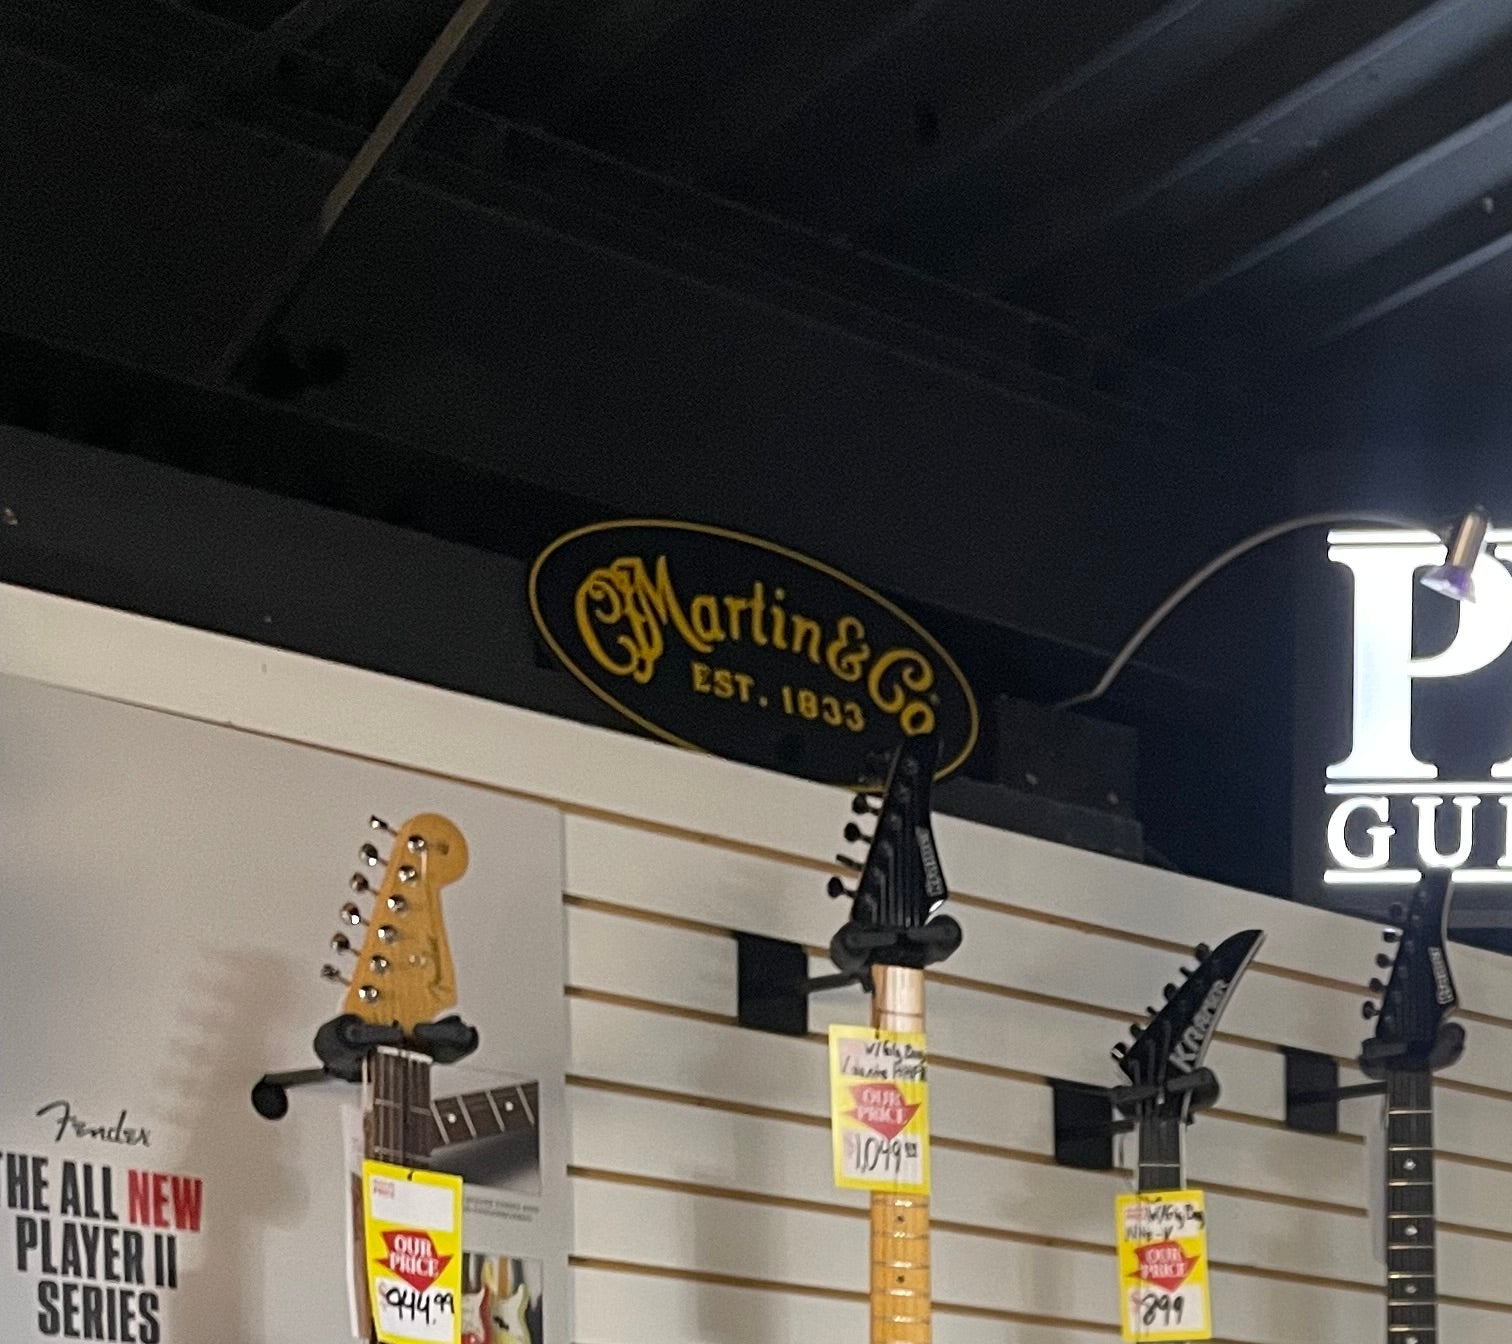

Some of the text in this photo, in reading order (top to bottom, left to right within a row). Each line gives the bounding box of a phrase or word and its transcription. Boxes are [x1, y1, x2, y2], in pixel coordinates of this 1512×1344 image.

[690, 662, 868, 733] EST. 1833
[36, 1100, 152, 1148] Fender
[0, 1150, 203, 1232] HE ALL NEW
[16, 1216, 178, 1289] PLAYER II
[393, 1233, 433, 1258] OUR
[1145, 1247, 1182, 1264] OUR
[388, 1252, 439, 1278] PRICE
[1140, 1263, 1186, 1280] PRICE
